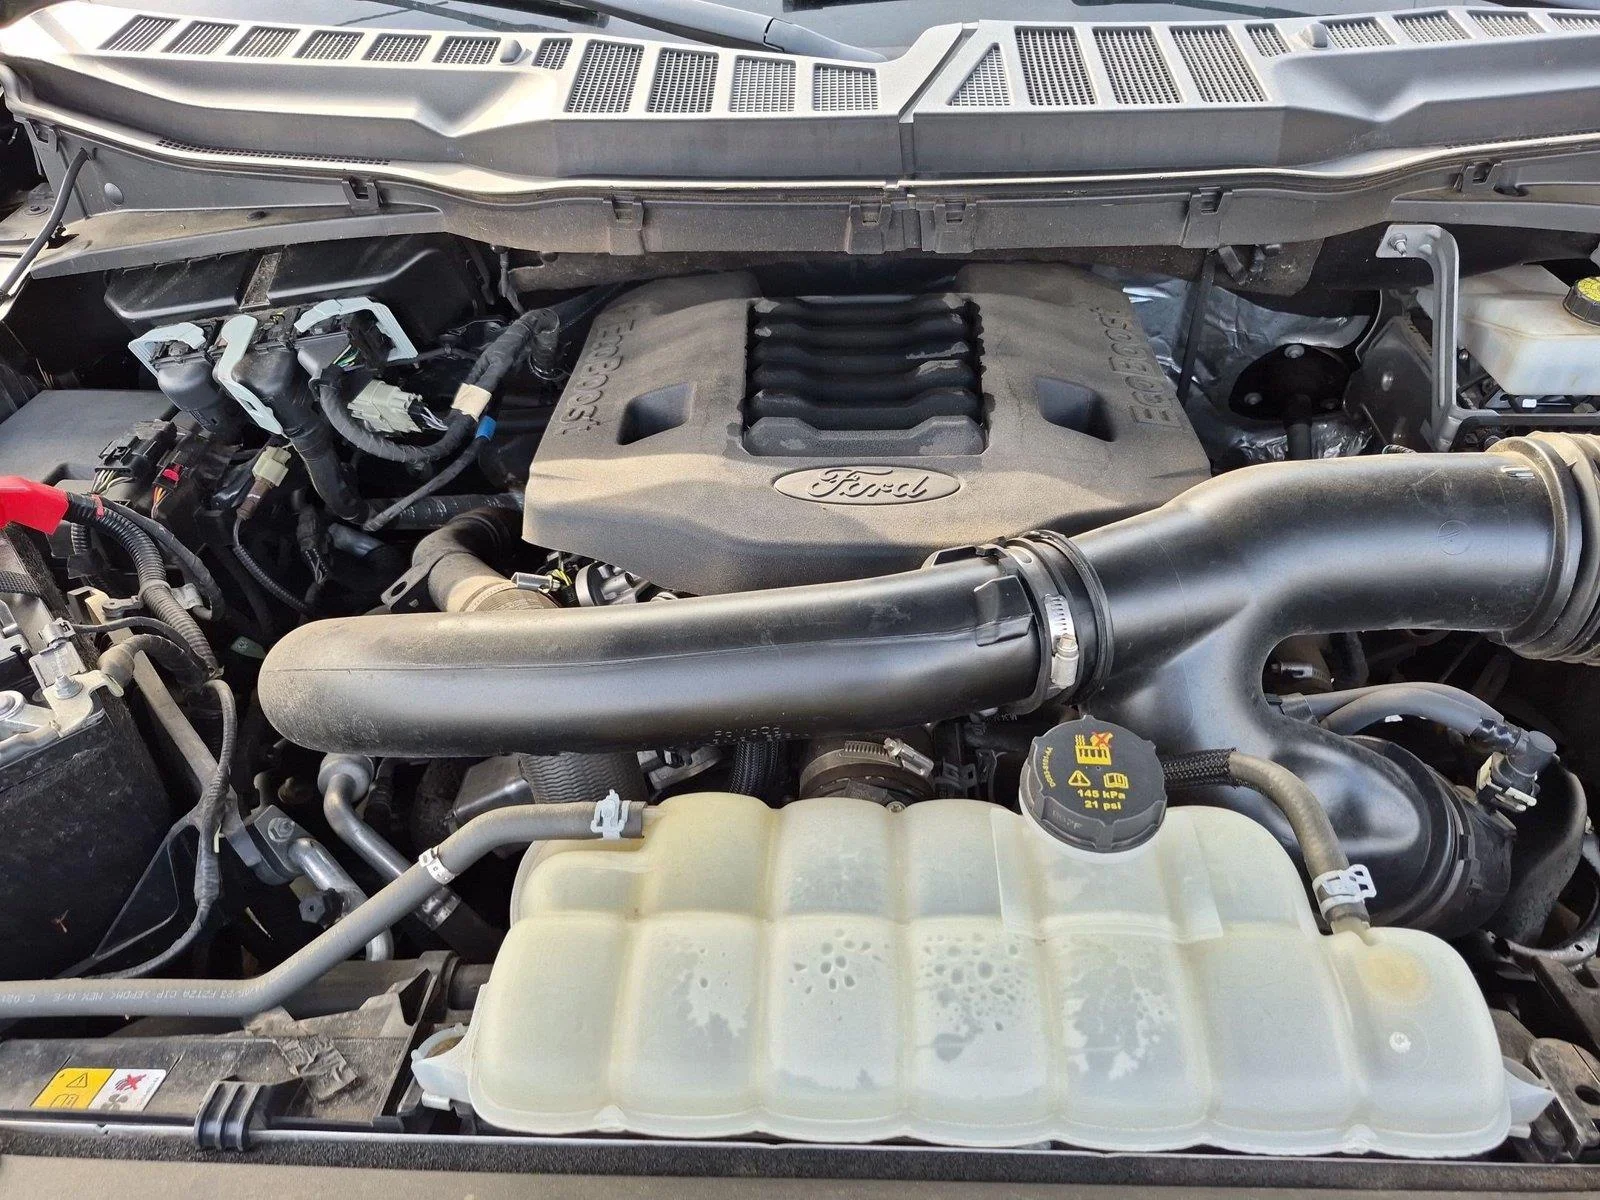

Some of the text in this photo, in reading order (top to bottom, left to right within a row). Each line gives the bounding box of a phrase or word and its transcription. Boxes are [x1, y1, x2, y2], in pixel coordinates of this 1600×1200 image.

[807, 469, 930, 499] Ford
[1077, 789, 1126, 800] 145 kPa
[1084, 800, 1122, 811] 21 psi
